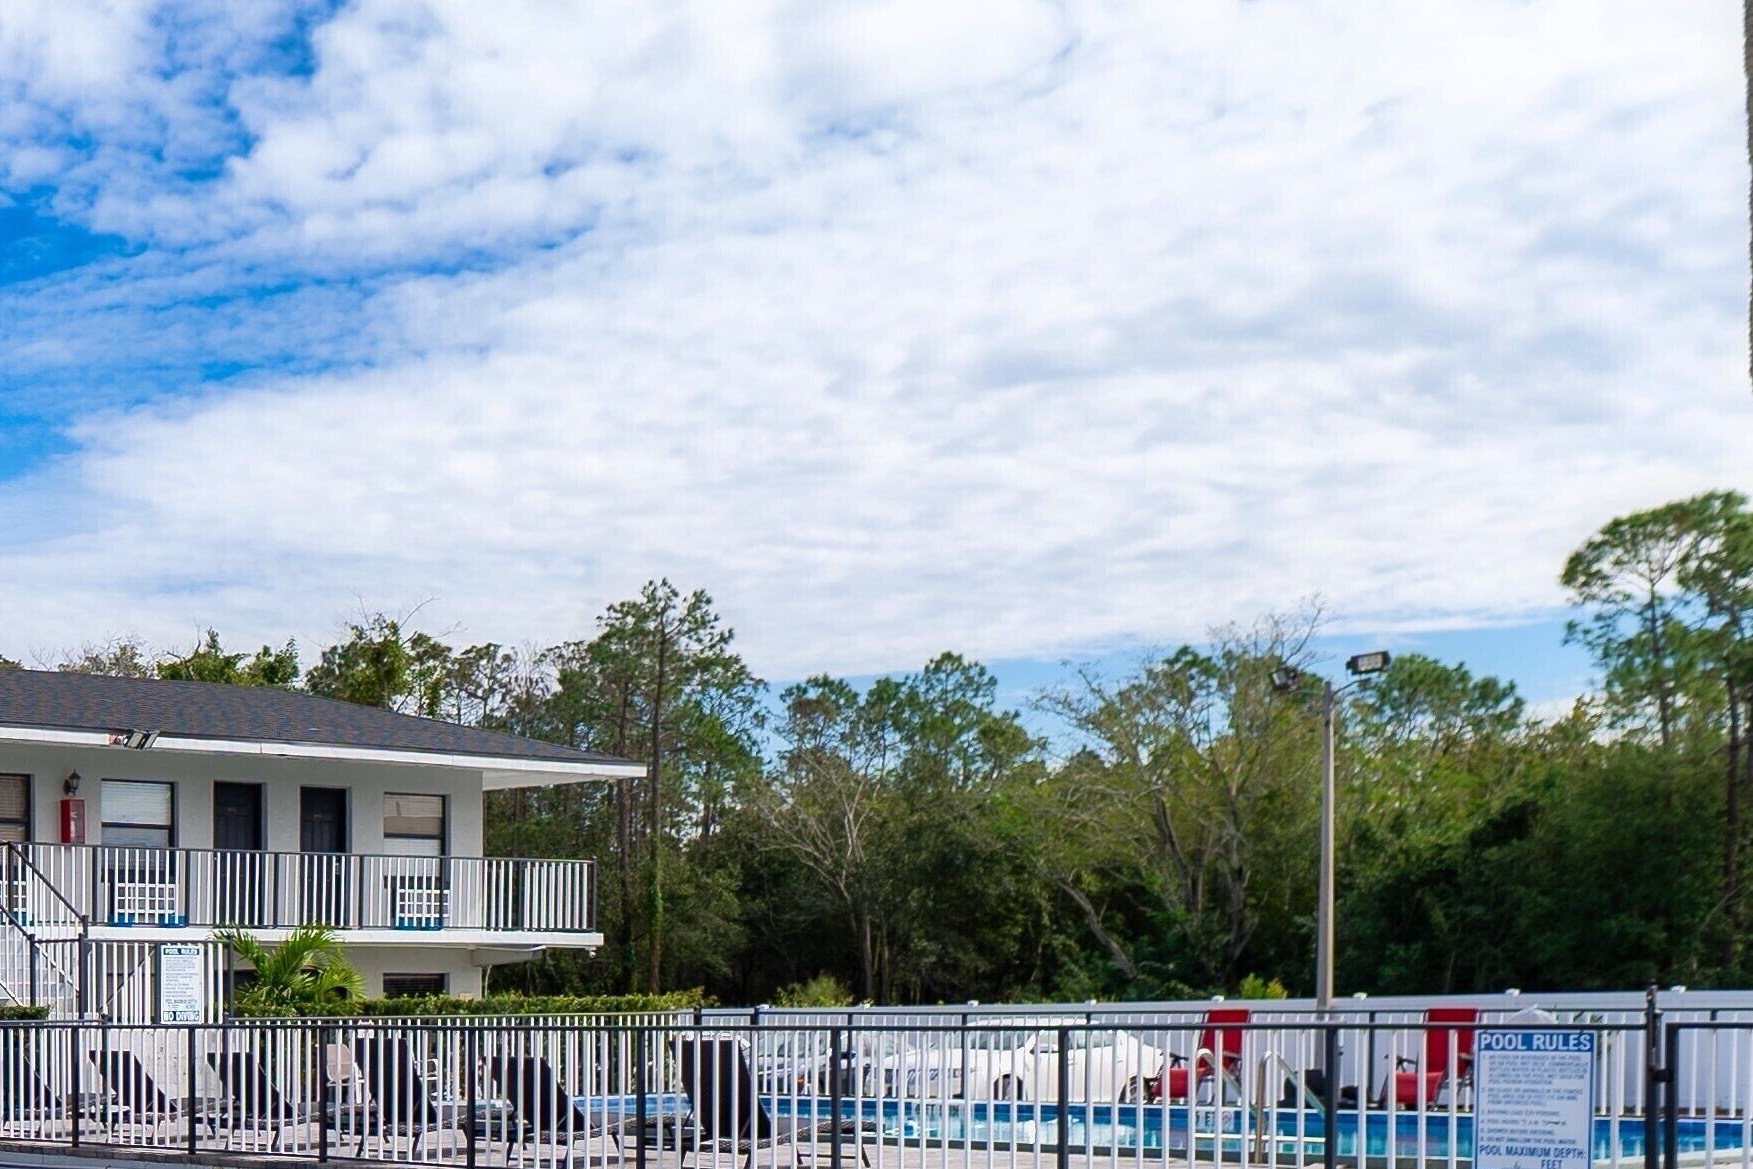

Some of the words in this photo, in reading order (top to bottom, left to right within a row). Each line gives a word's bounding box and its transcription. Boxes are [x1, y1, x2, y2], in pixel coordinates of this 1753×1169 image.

[1480, 1033, 1527, 1050] POOL
[1533, 1034, 1591, 1051] RULES
[1479, 1145, 1502, 1156] POOL
[1505, 1146, 1551, 1157] MAXIMUM
[1541, 1160, 1563, 1169] FEET
